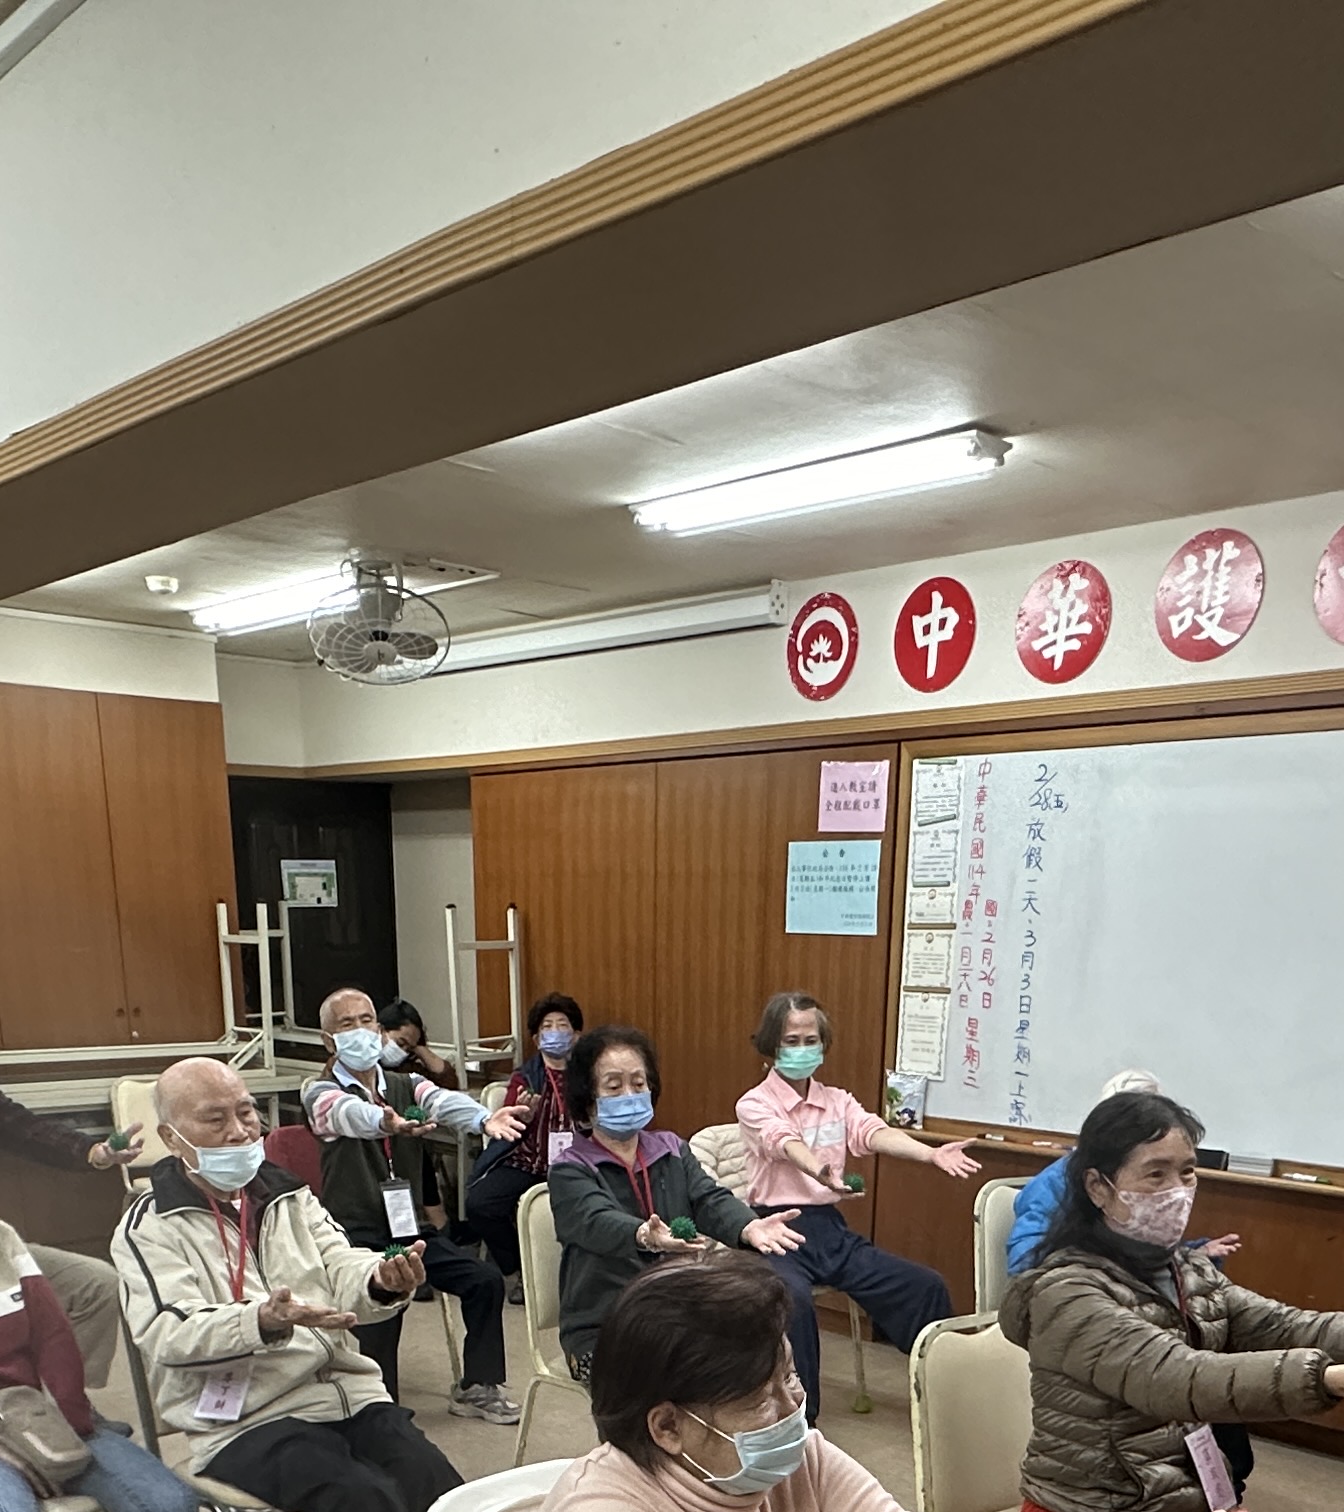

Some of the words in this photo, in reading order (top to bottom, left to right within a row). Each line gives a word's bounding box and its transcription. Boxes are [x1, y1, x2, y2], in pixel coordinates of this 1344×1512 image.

[830, 779, 877, 794] 進入教室請
[825, 798, 881, 812] 全程配戴口罩
[962, 1016, 981, 1089] 星期三
